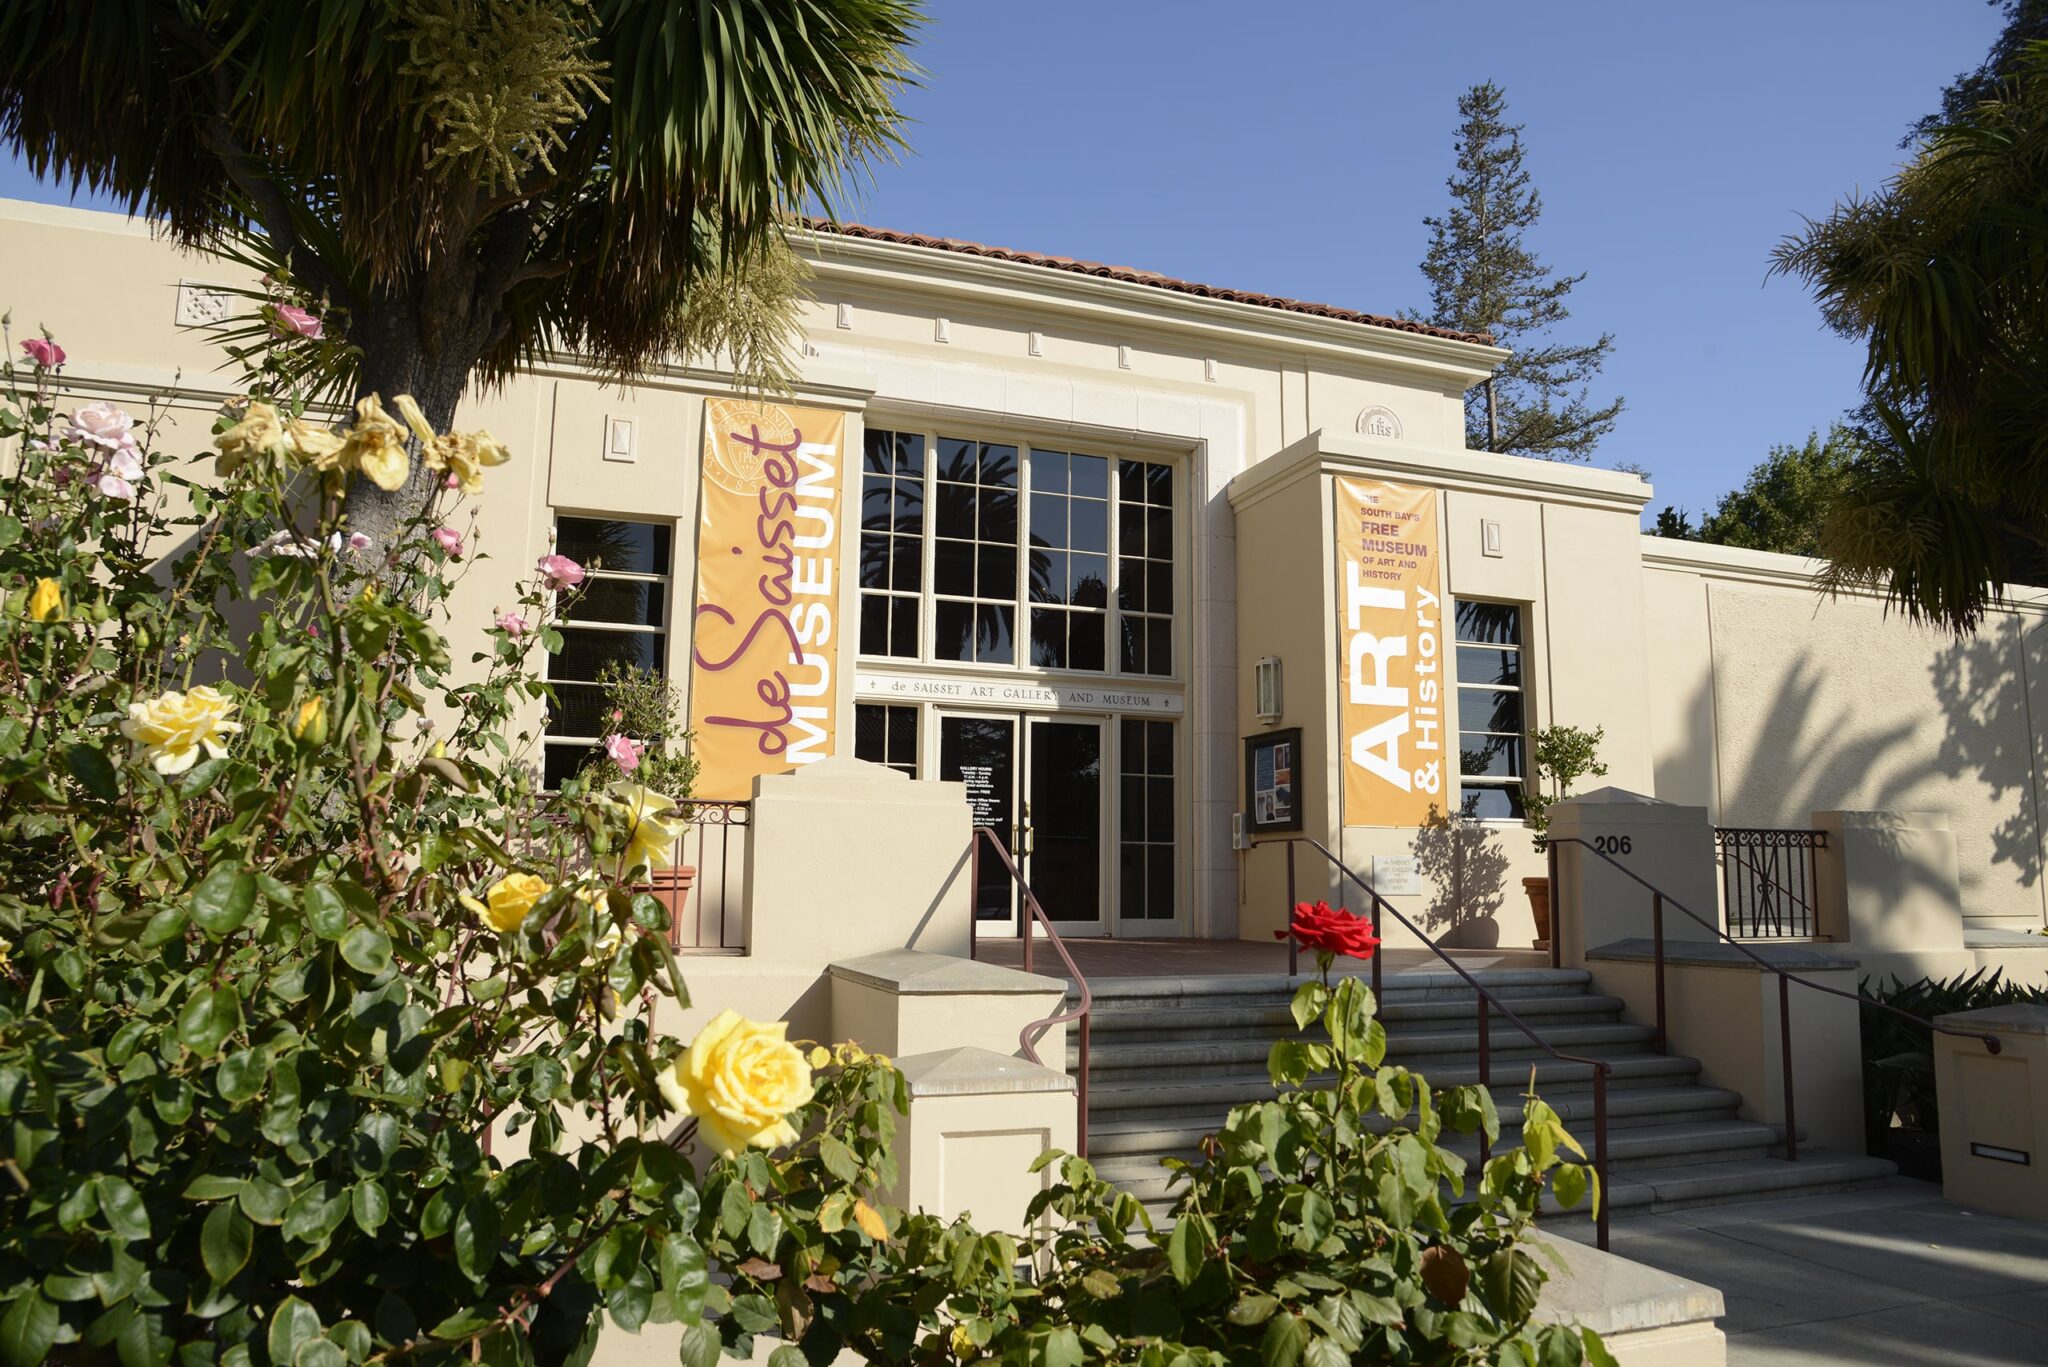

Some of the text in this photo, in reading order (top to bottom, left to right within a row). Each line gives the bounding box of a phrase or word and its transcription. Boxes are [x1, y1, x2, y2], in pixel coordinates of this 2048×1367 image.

[1360, 507, 1420, 522] SOUTH BAY'S
[1361, 521, 1400, 537] FREE
[1362, 539, 1427, 557] MUSEUM
[1362, 556, 1417, 569] OF ART AND
[1362, 569, 1402, 581] HISTORY
[693, 423, 804, 755] de Saisset
[785, 441, 836, 764] MUSEUM
[1346, 560, 1412, 793] ART
[891, 681, 1150, 707] de SAISSET ART GALLERY AND MUSEUM
[1414, 584, 1440, 795] & History
[1594, 835, 1632, 855] 206
